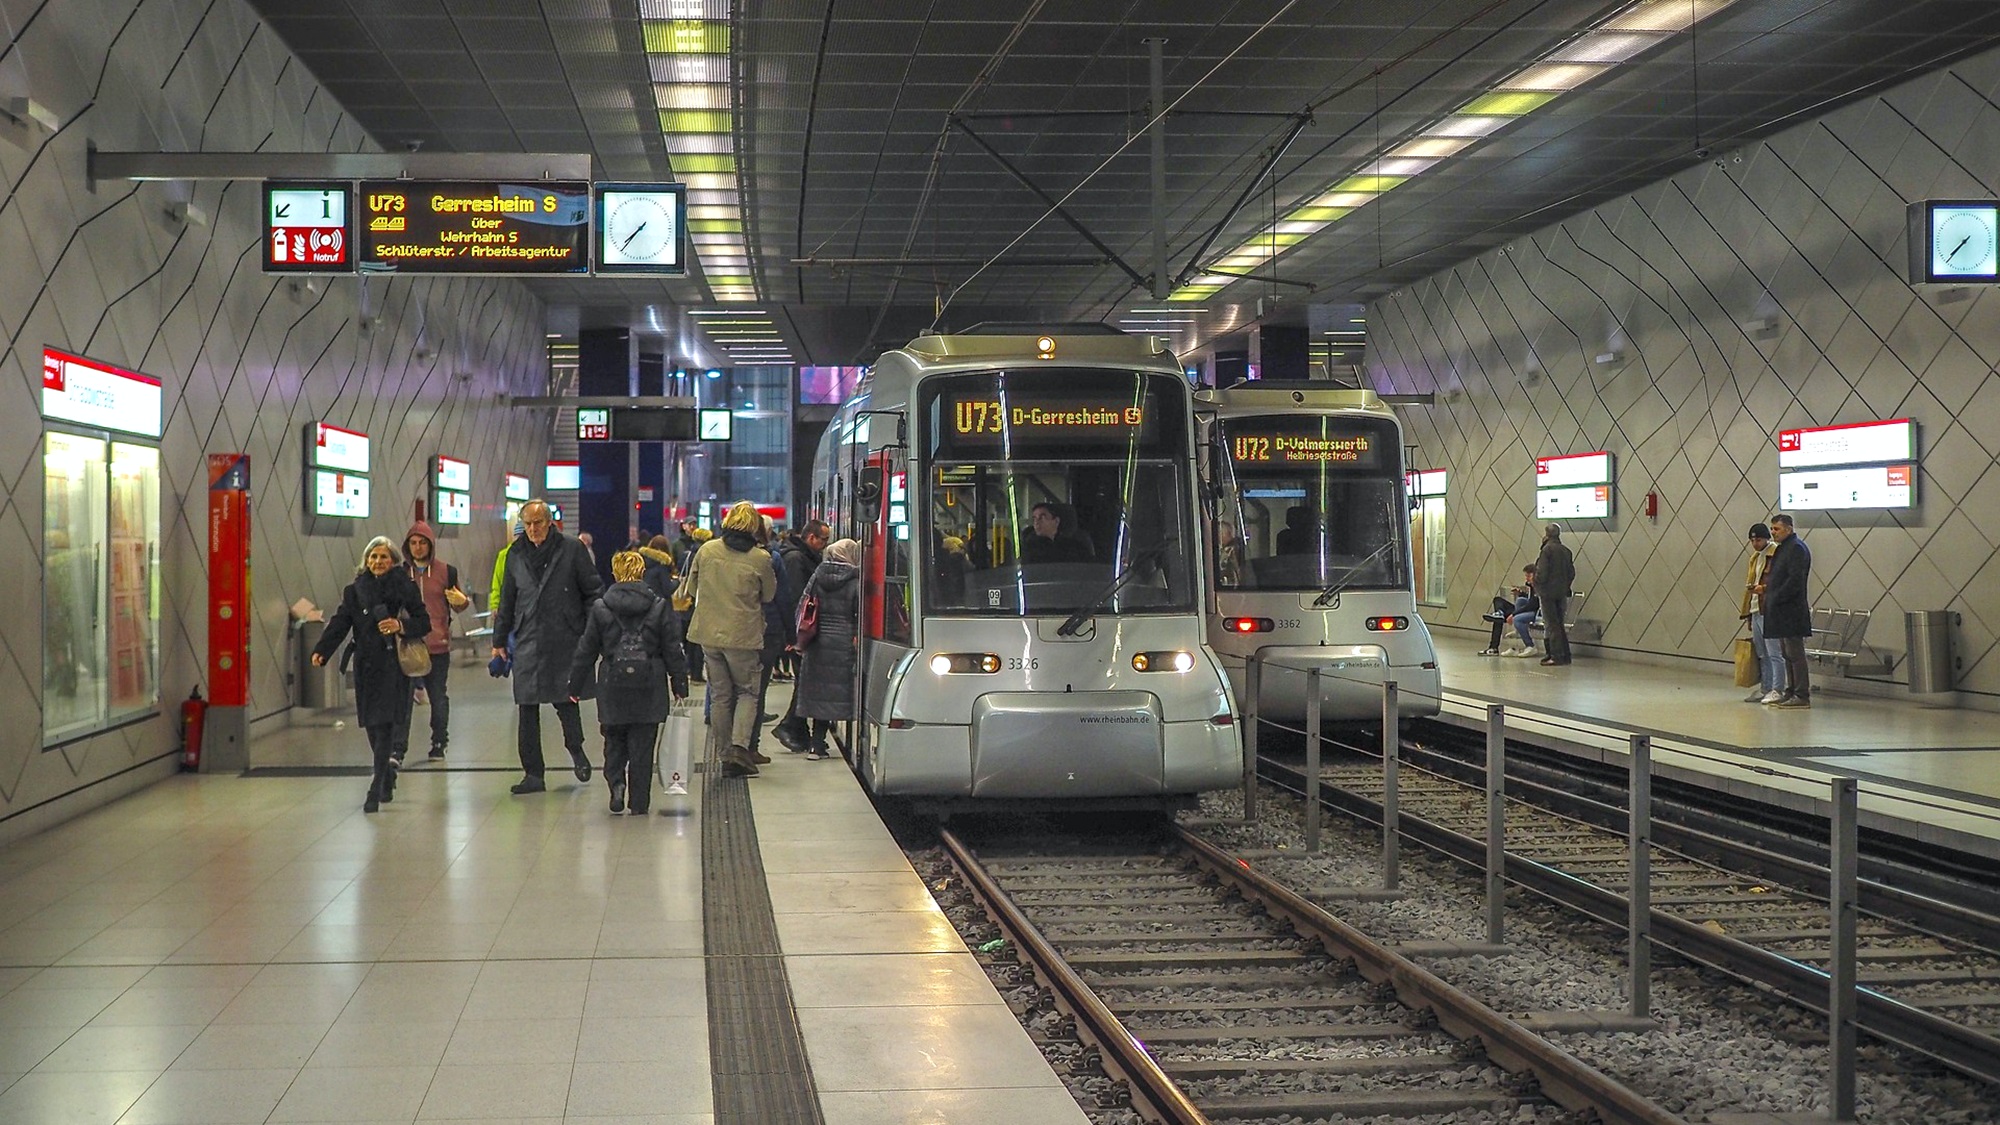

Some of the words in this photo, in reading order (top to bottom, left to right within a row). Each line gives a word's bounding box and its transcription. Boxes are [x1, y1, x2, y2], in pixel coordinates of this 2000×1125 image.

[369, 195, 405, 212] U73
[431, 195, 534, 213] Gerresheim
[542, 195, 557, 212] S
[471, 217, 503, 229] über
[440, 232, 505, 244] Wehrhahn
[508, 232, 518, 243] S
[313, 252, 339, 262] Notruf
[375, 245, 455, 258] Schlüterstr.
[471, 245, 570, 259] Arbeitsagentur
[956, 402, 1003, 432] U73
[1012, 407, 1119, 426] D-Gerresheim
[1235, 437, 1270, 461] U72
[1276, 437, 1368, 452] D-Volmerswerth
[1278, 619, 1301, 629] 3362
[1008, 657, 1039, 671] 3326
[1079, 715, 1150, 725] www.rheinbahn.de
